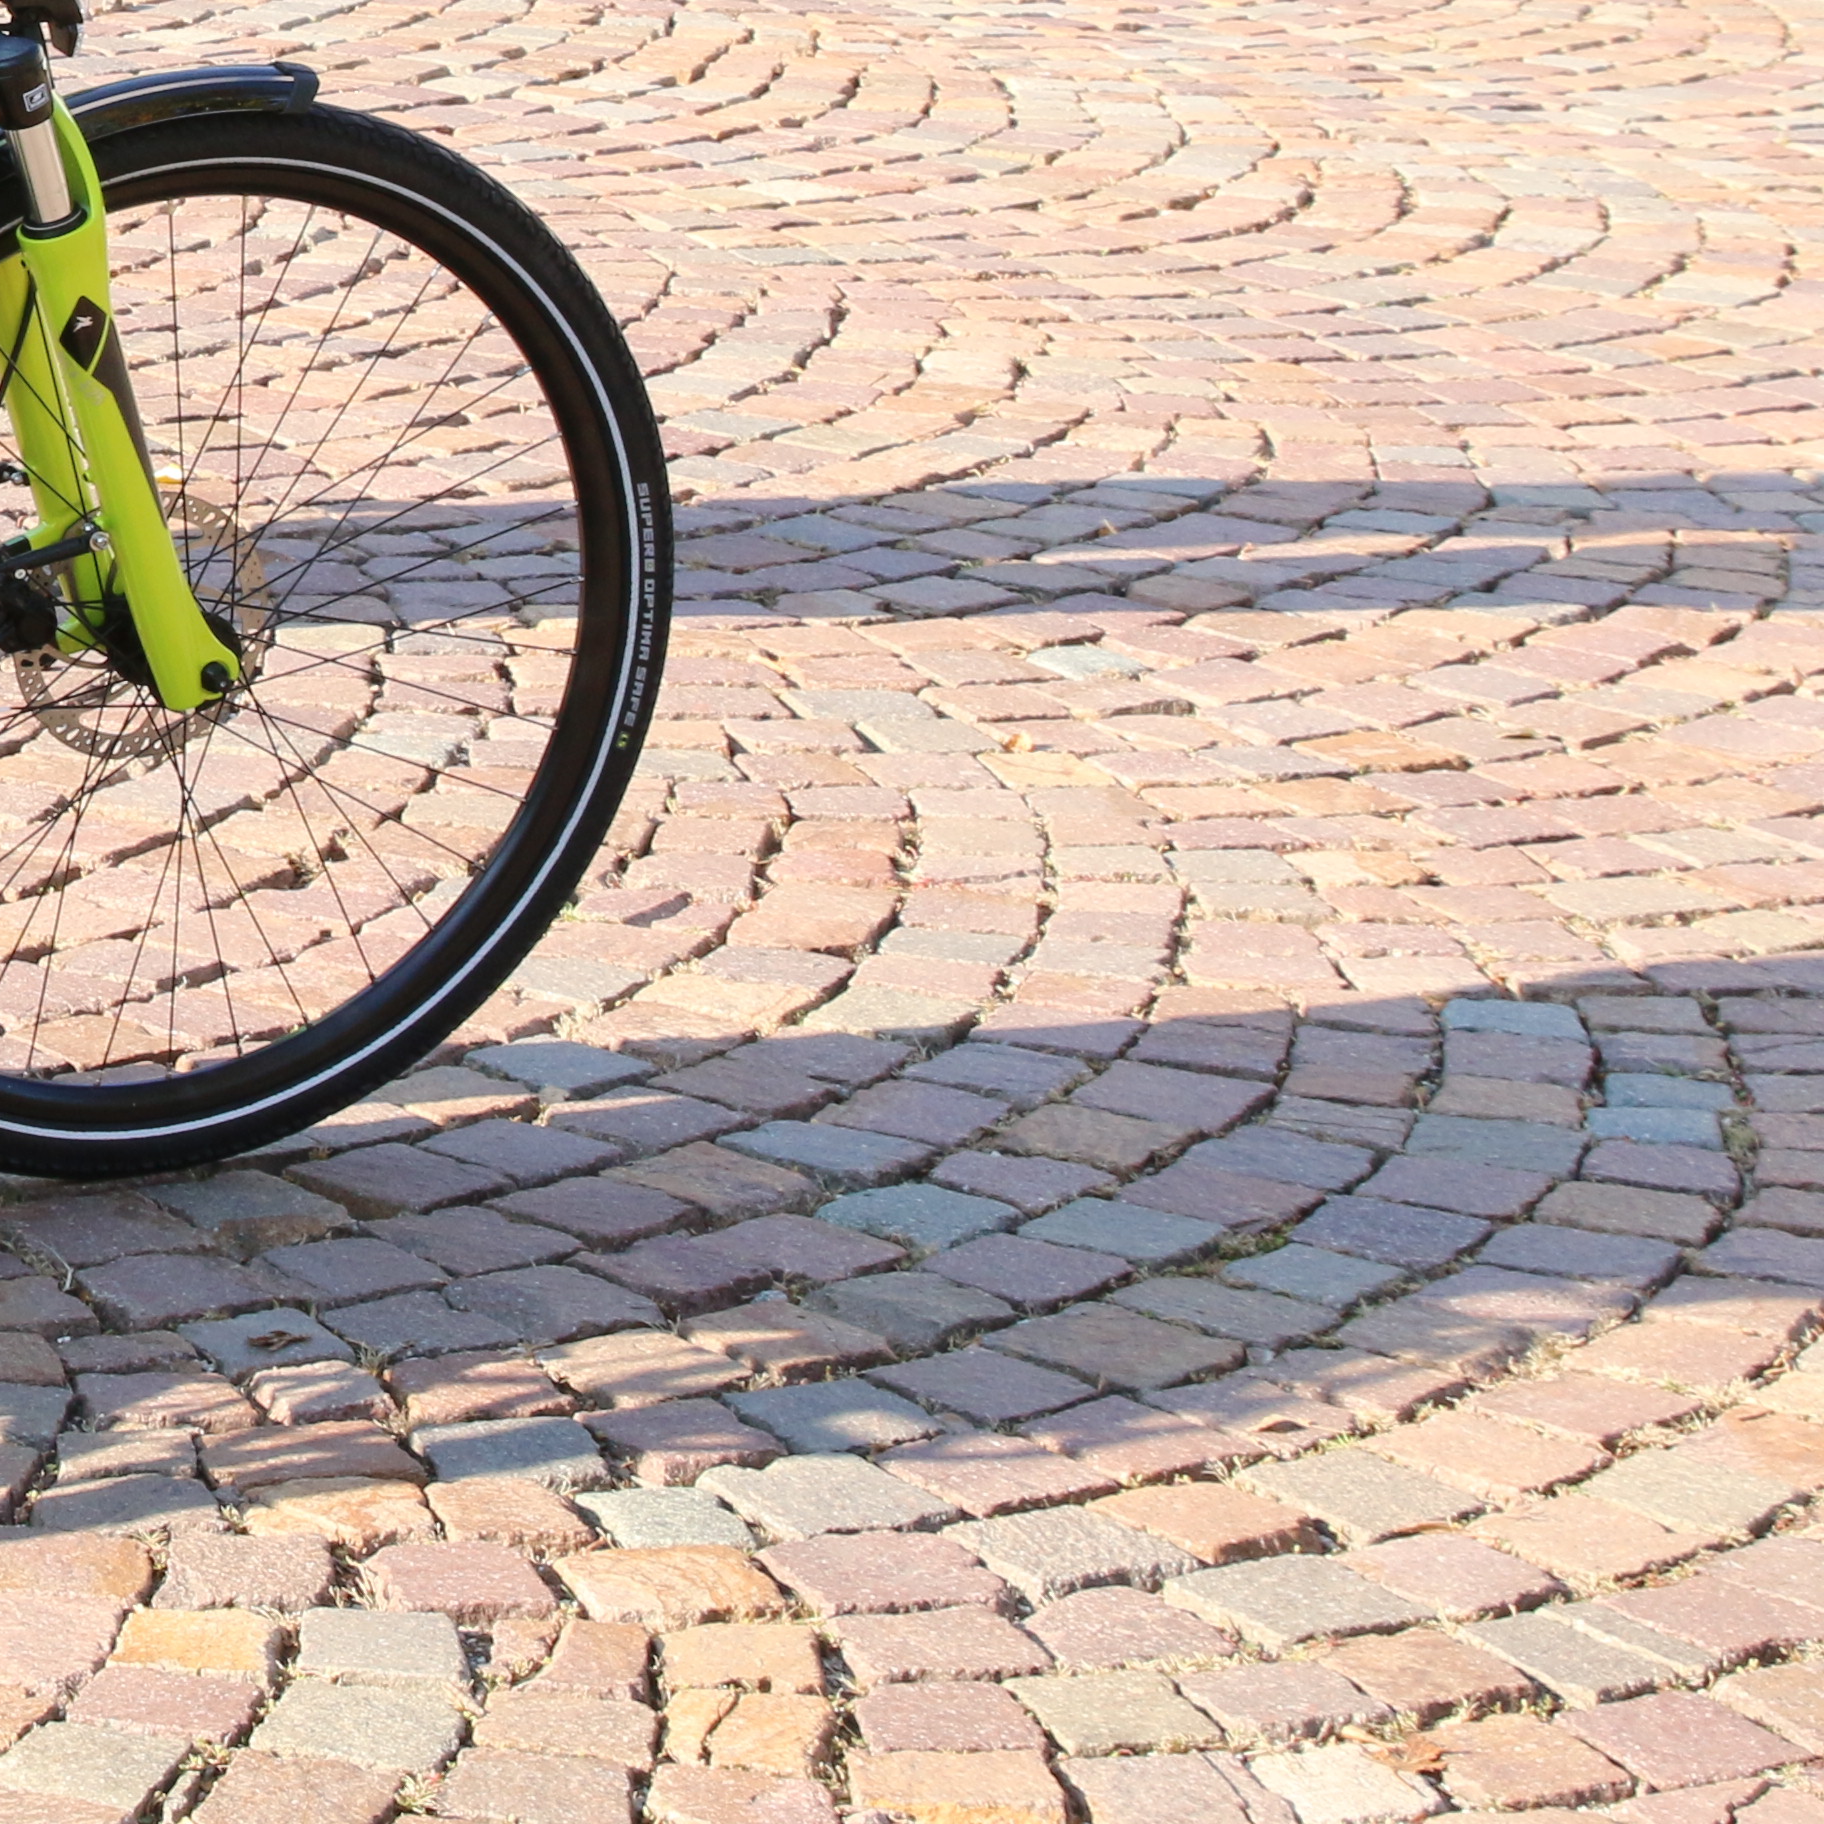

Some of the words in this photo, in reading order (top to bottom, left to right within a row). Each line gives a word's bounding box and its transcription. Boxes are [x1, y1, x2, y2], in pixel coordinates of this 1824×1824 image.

[636, 482, 656, 573] SUPERB
[639, 578, 656, 661] OPTIMA
[623, 662, 647, 727] SAFE
